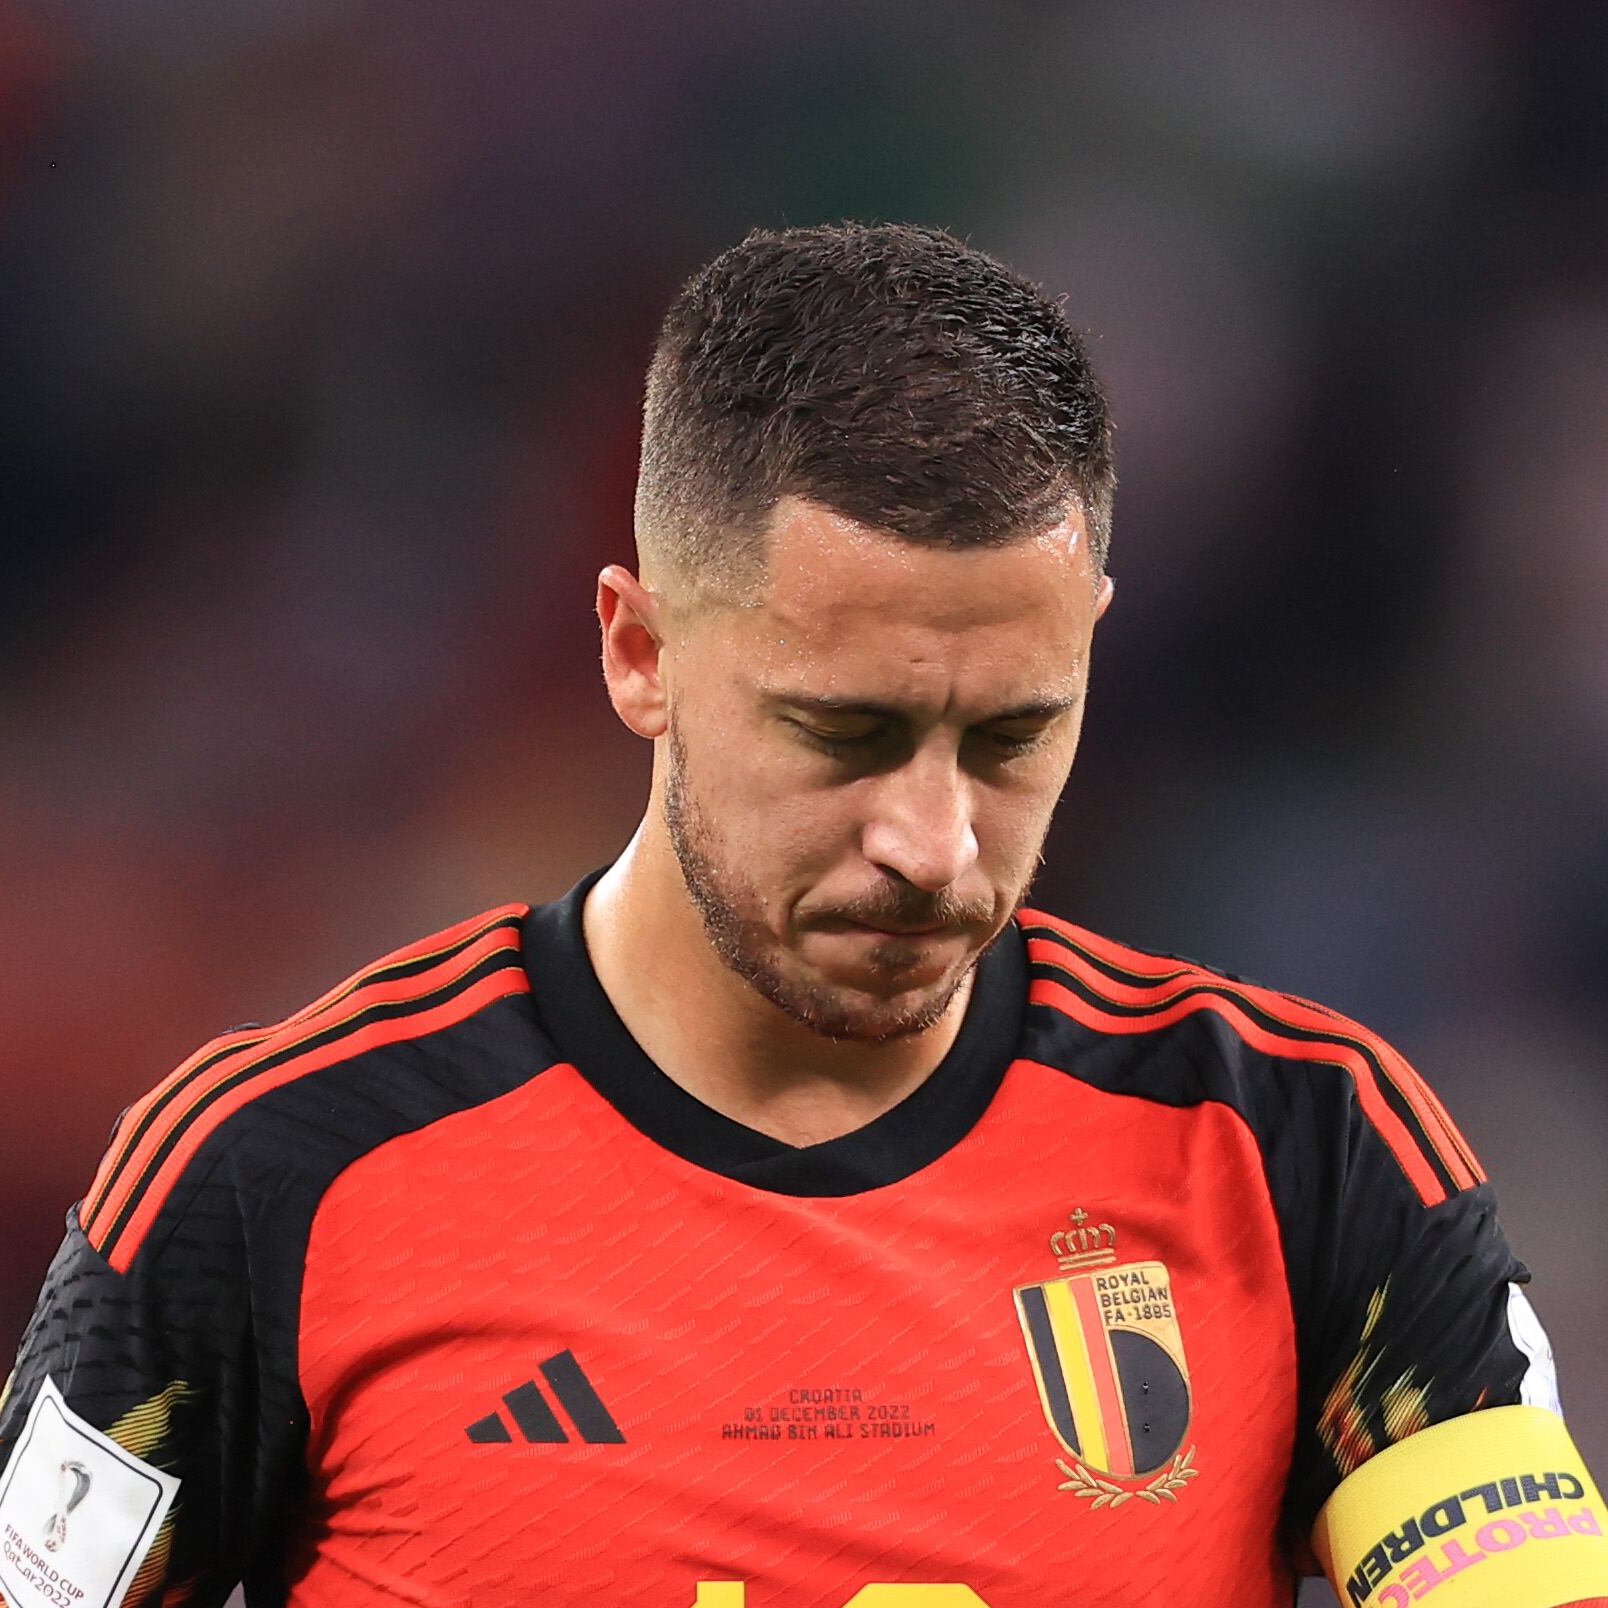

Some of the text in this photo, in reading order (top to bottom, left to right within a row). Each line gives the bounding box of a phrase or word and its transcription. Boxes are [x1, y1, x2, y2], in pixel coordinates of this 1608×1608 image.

[1096, 1271, 1150, 1291] ROYAL
[1100, 1287, 1169, 1308] BELGIAN
[790, 1389, 862, 1405] CROATIA
[771, 1406, 861, 1421] DECEMBER
[868, 1405, 910, 1420] 2022
[825, 1424, 853, 1439] ALI
[860, 1422, 935, 1438] STADIUM
[5, 1524, 84, 1599] FIFA WORLD CUP
